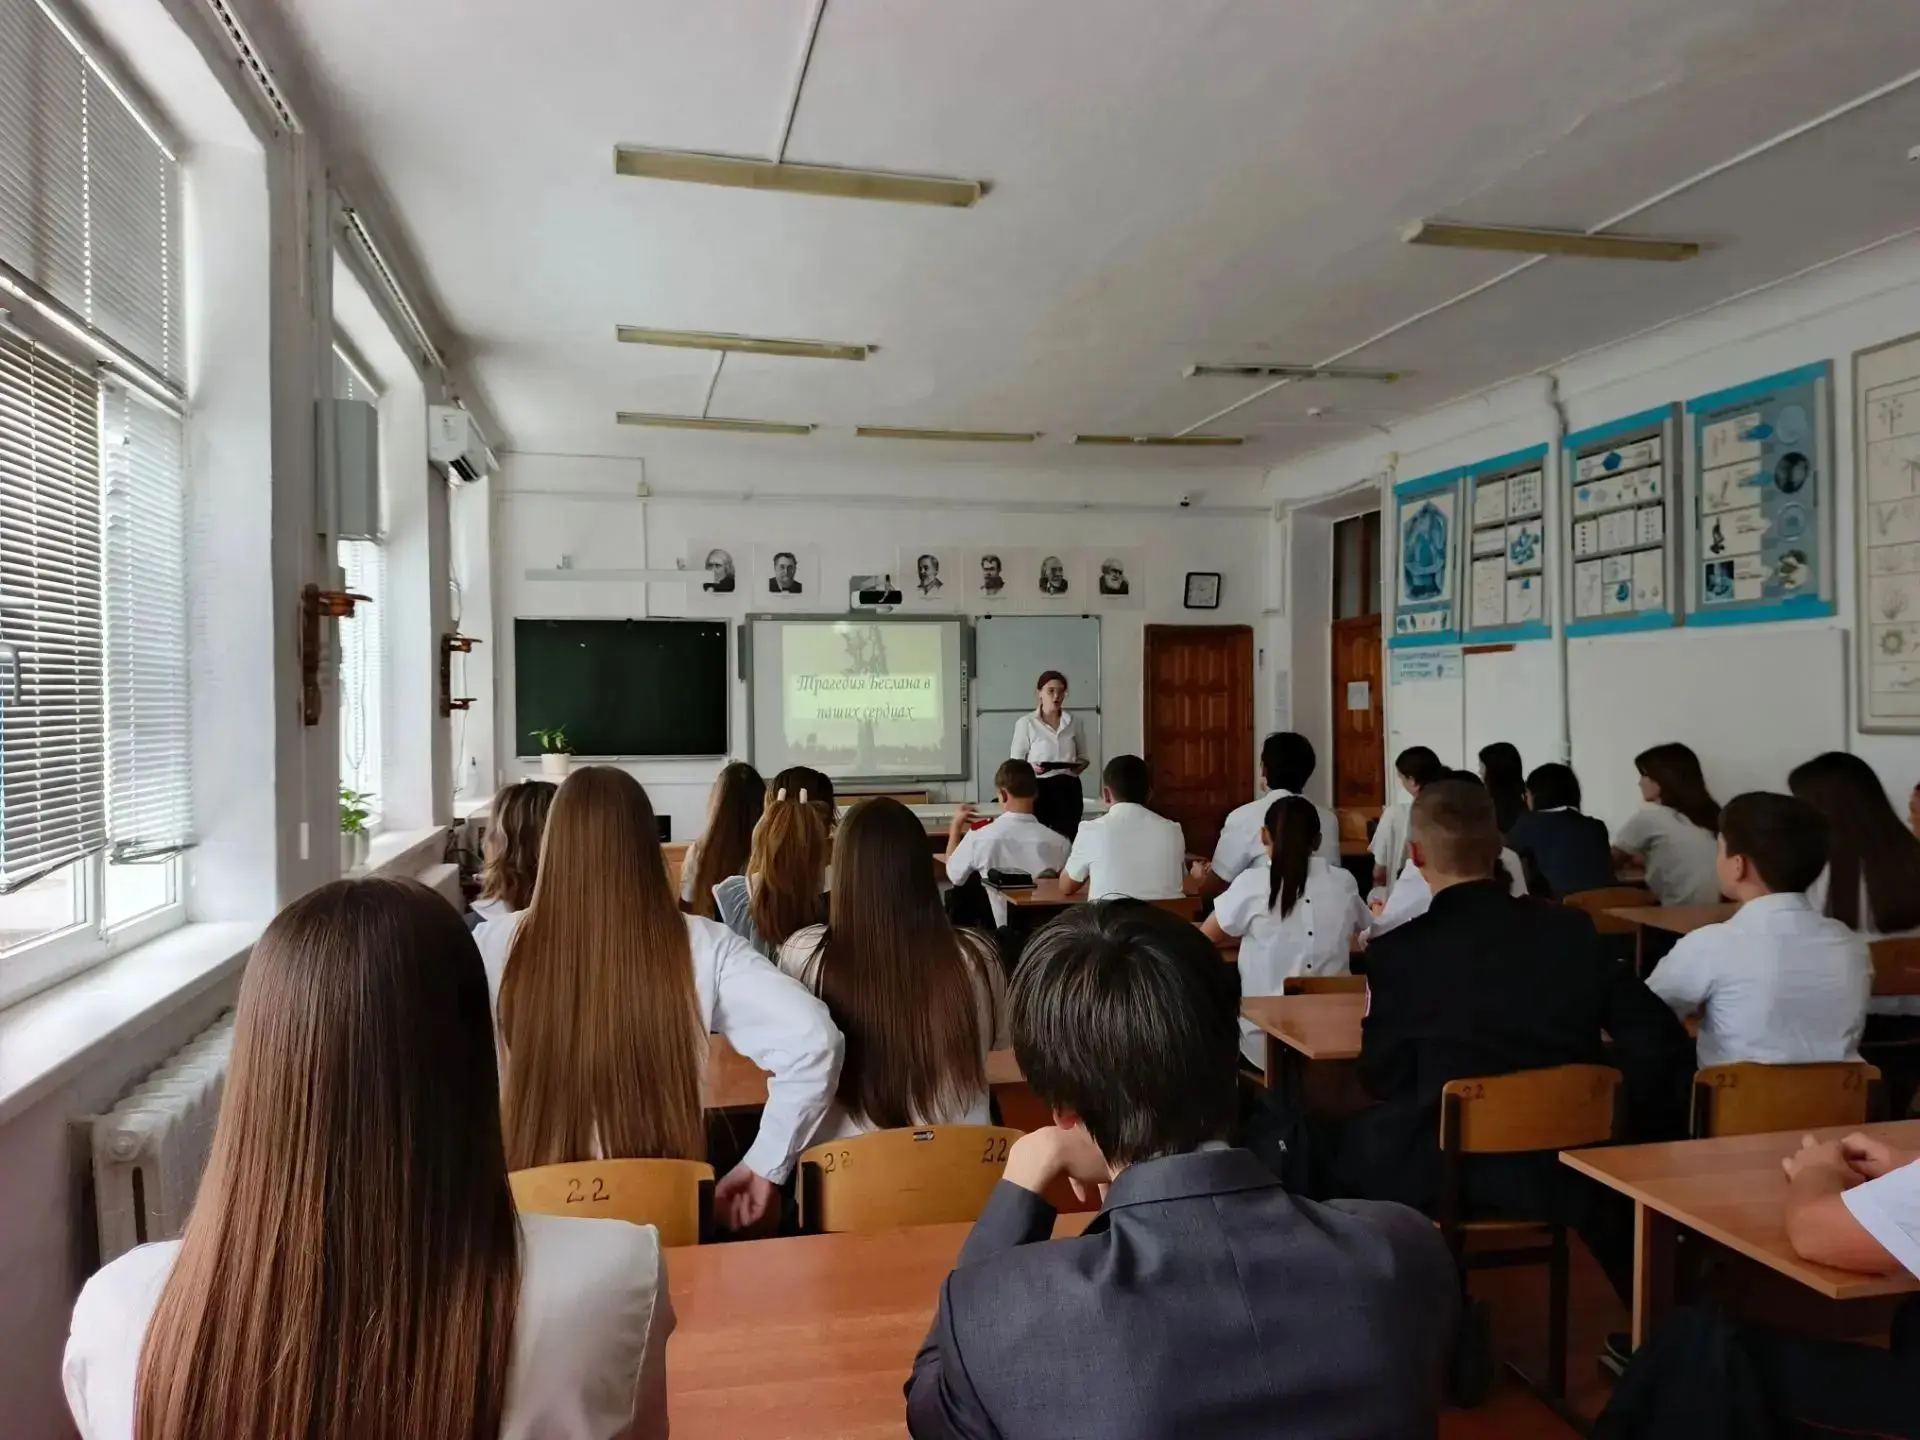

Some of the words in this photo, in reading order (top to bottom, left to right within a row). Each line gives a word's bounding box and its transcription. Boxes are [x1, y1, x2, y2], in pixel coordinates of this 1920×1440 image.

[796, 674, 865, 696] Трагедия
[924, 678, 931, 690] в
[816, 704, 862, 721] наших
[862, 702, 916, 722] сердцах
[981, 1137, 1008, 1163] 22
[566, 1177, 610, 1203] 22
